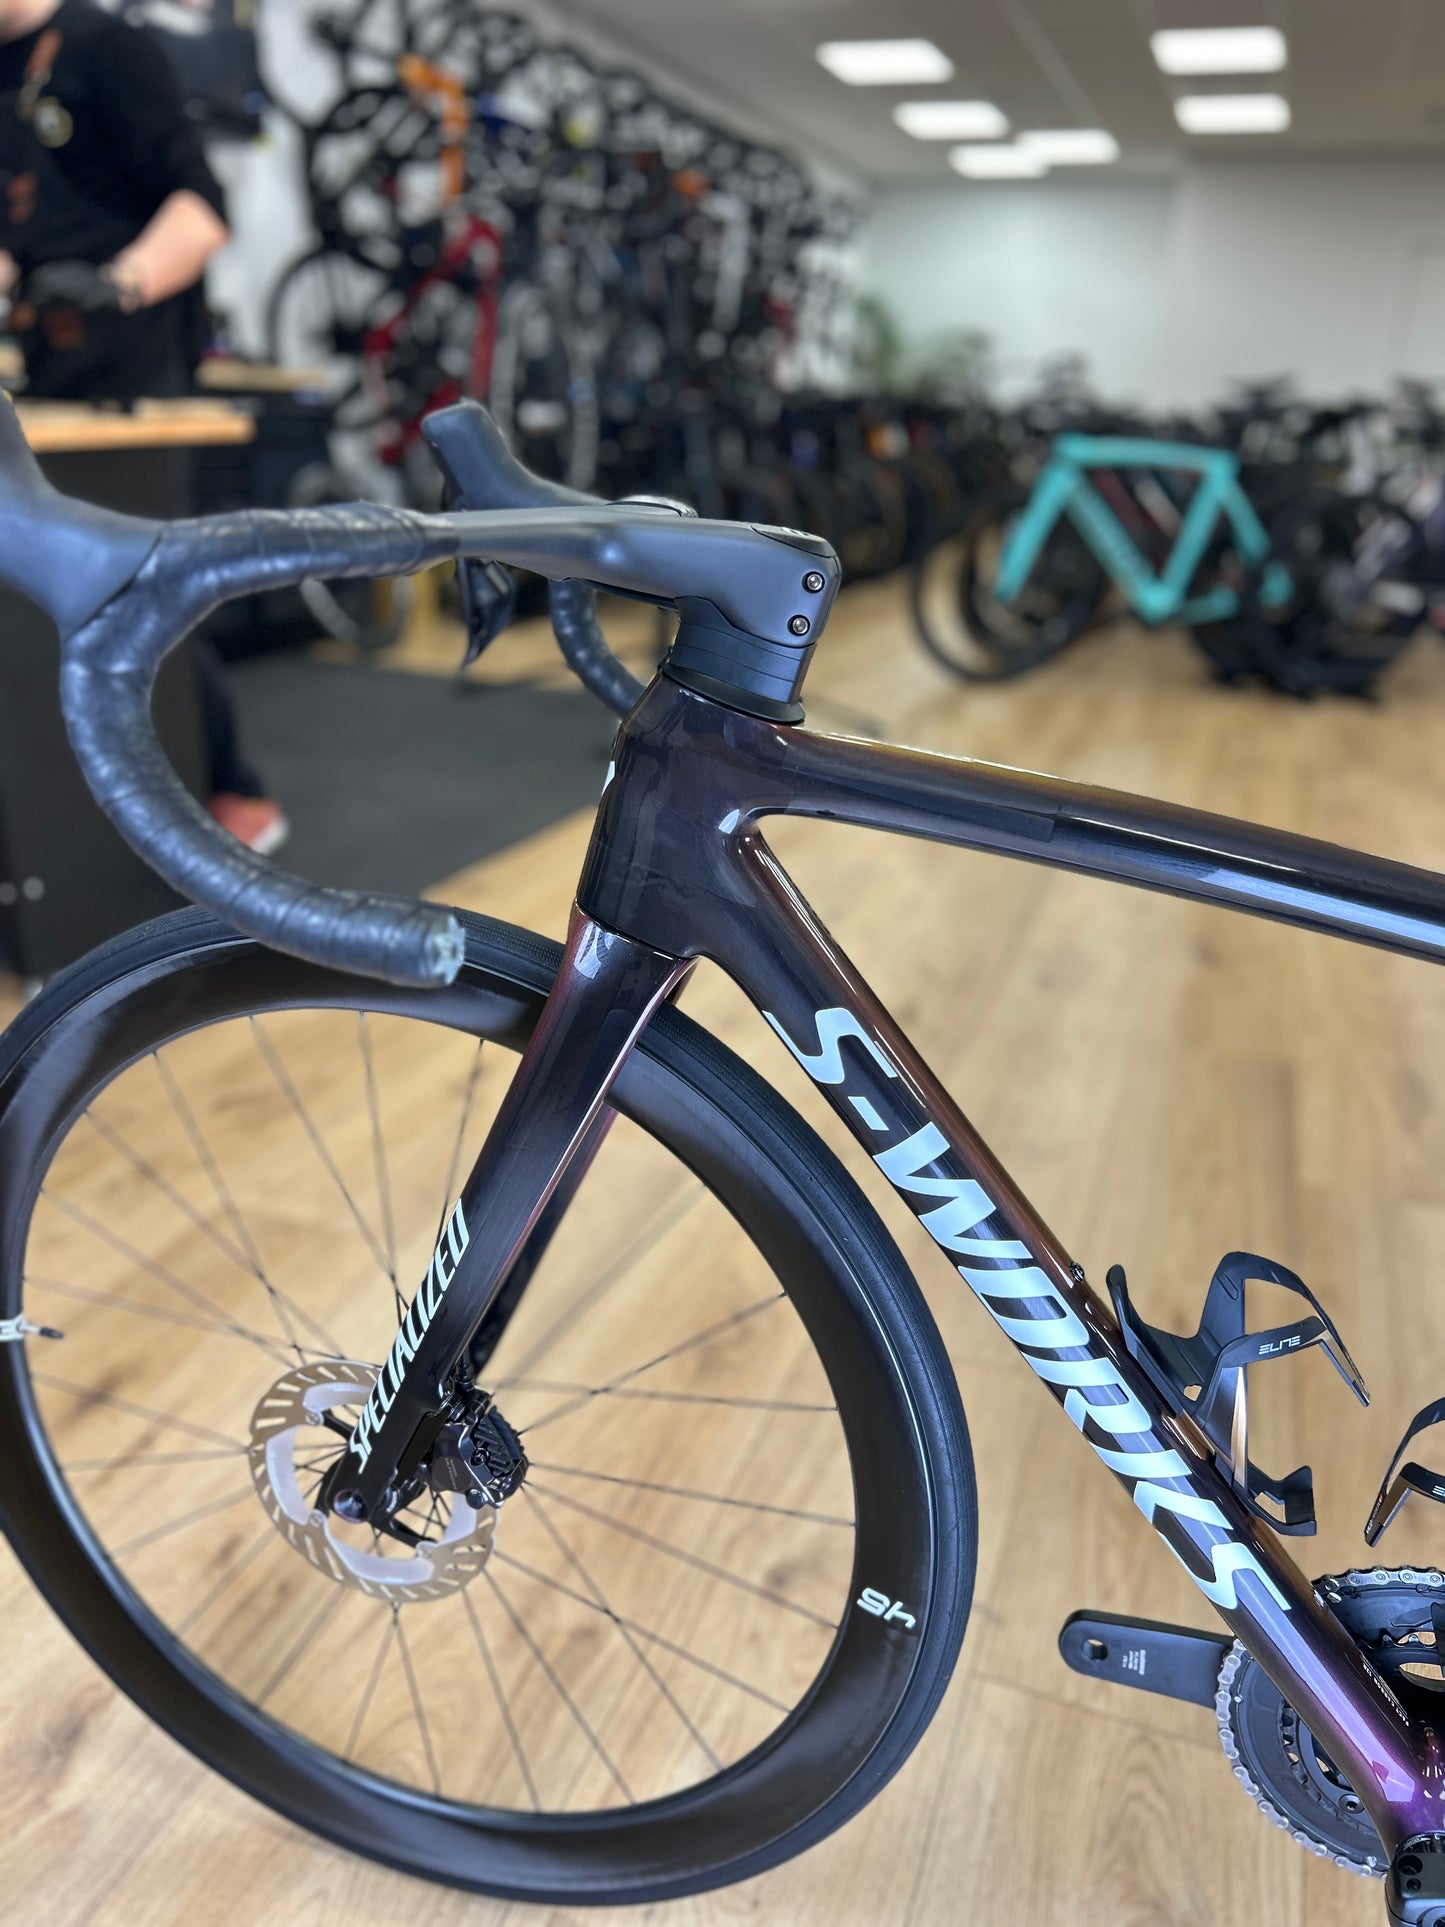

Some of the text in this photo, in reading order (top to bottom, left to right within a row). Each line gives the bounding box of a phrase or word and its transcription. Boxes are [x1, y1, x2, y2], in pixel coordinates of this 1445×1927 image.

[350, 1198, 470, 1474] SPECIALIZED
[762, 1007, 1291, 1610] S-WORKS
[1258, 1335, 1301, 1355] ELITE
